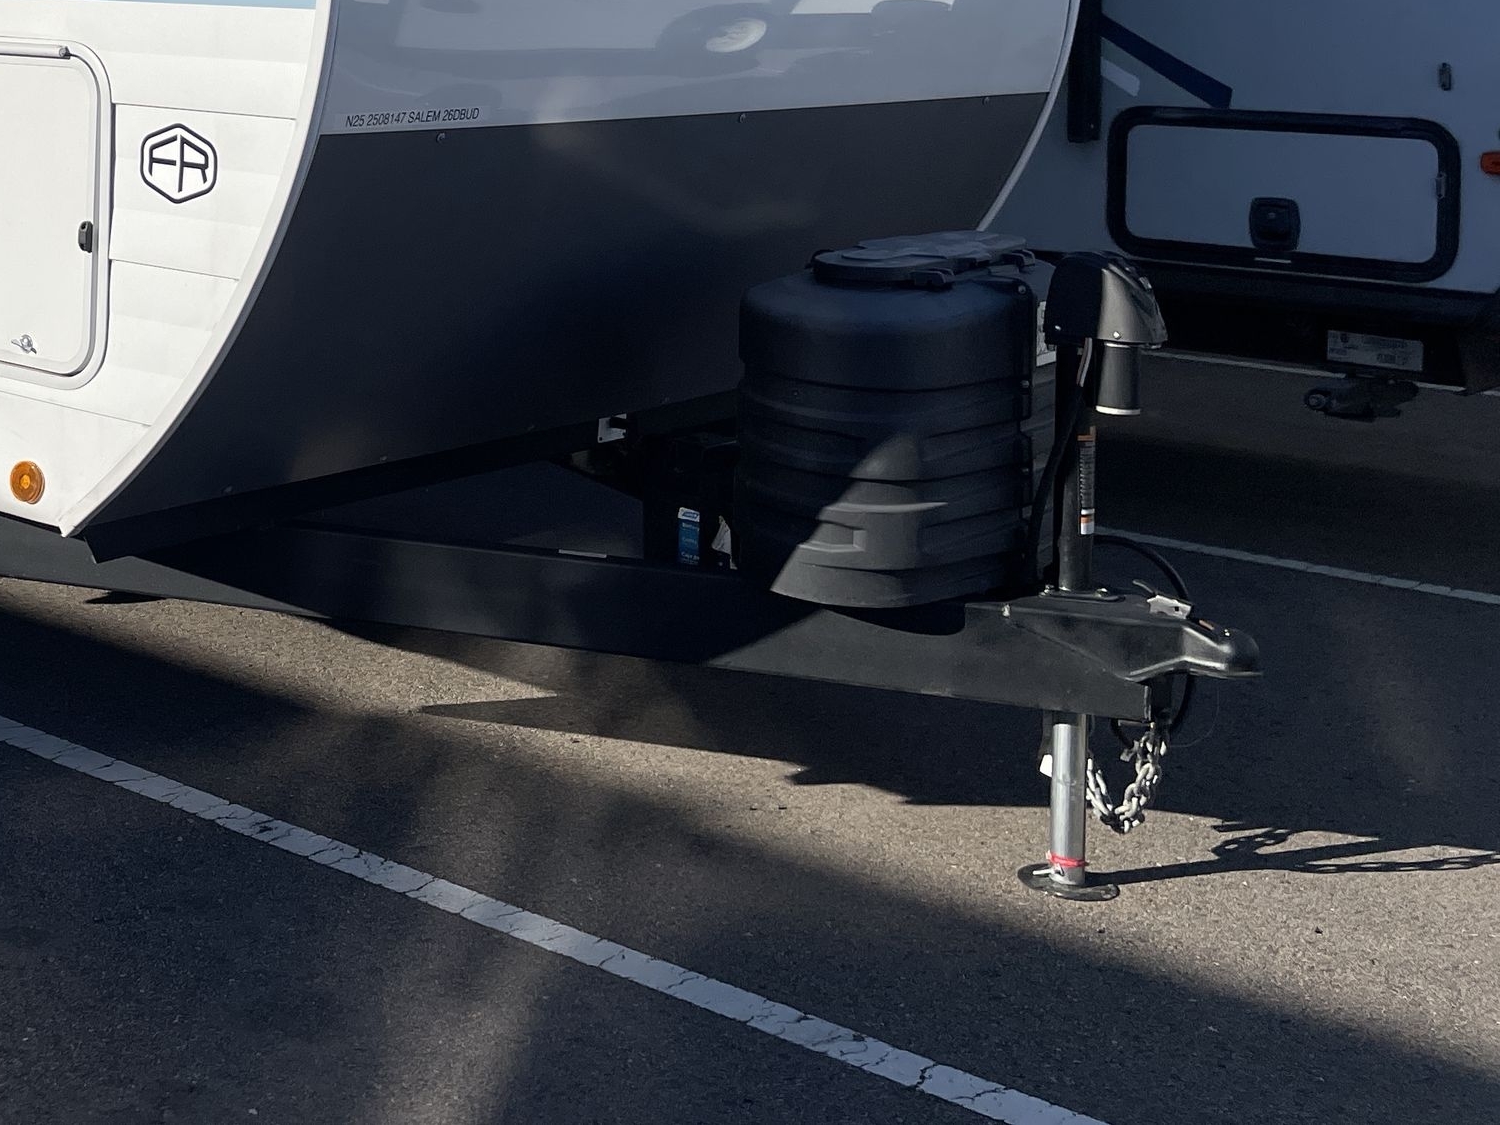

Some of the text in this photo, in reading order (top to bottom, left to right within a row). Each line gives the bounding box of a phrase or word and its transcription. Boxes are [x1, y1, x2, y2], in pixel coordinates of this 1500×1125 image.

[346, 107, 480, 127] N25 2508147 SALEM 26DBUD
